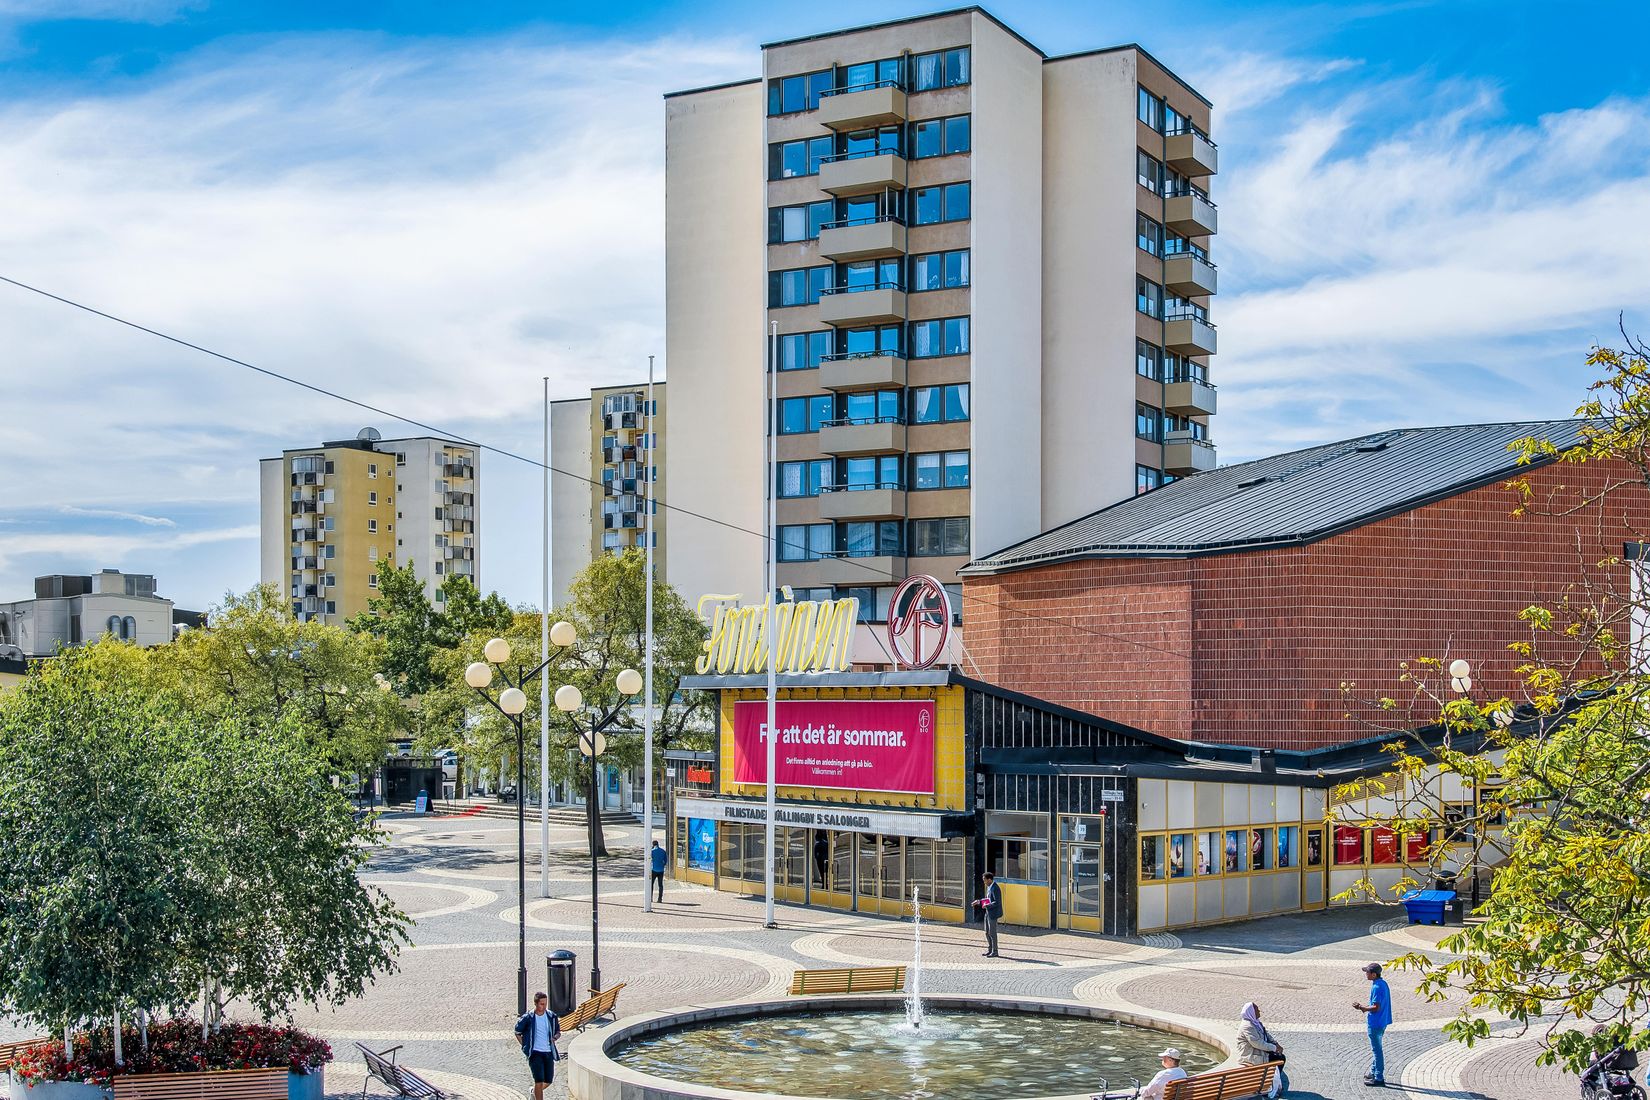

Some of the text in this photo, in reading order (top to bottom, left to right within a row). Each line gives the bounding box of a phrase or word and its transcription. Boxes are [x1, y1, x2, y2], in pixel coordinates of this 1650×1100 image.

[759, 723, 906, 747] Fr att det är sommar.
[725, 807, 869, 828] FILMSTADE ÄLLINGBY 5 SALONGER
